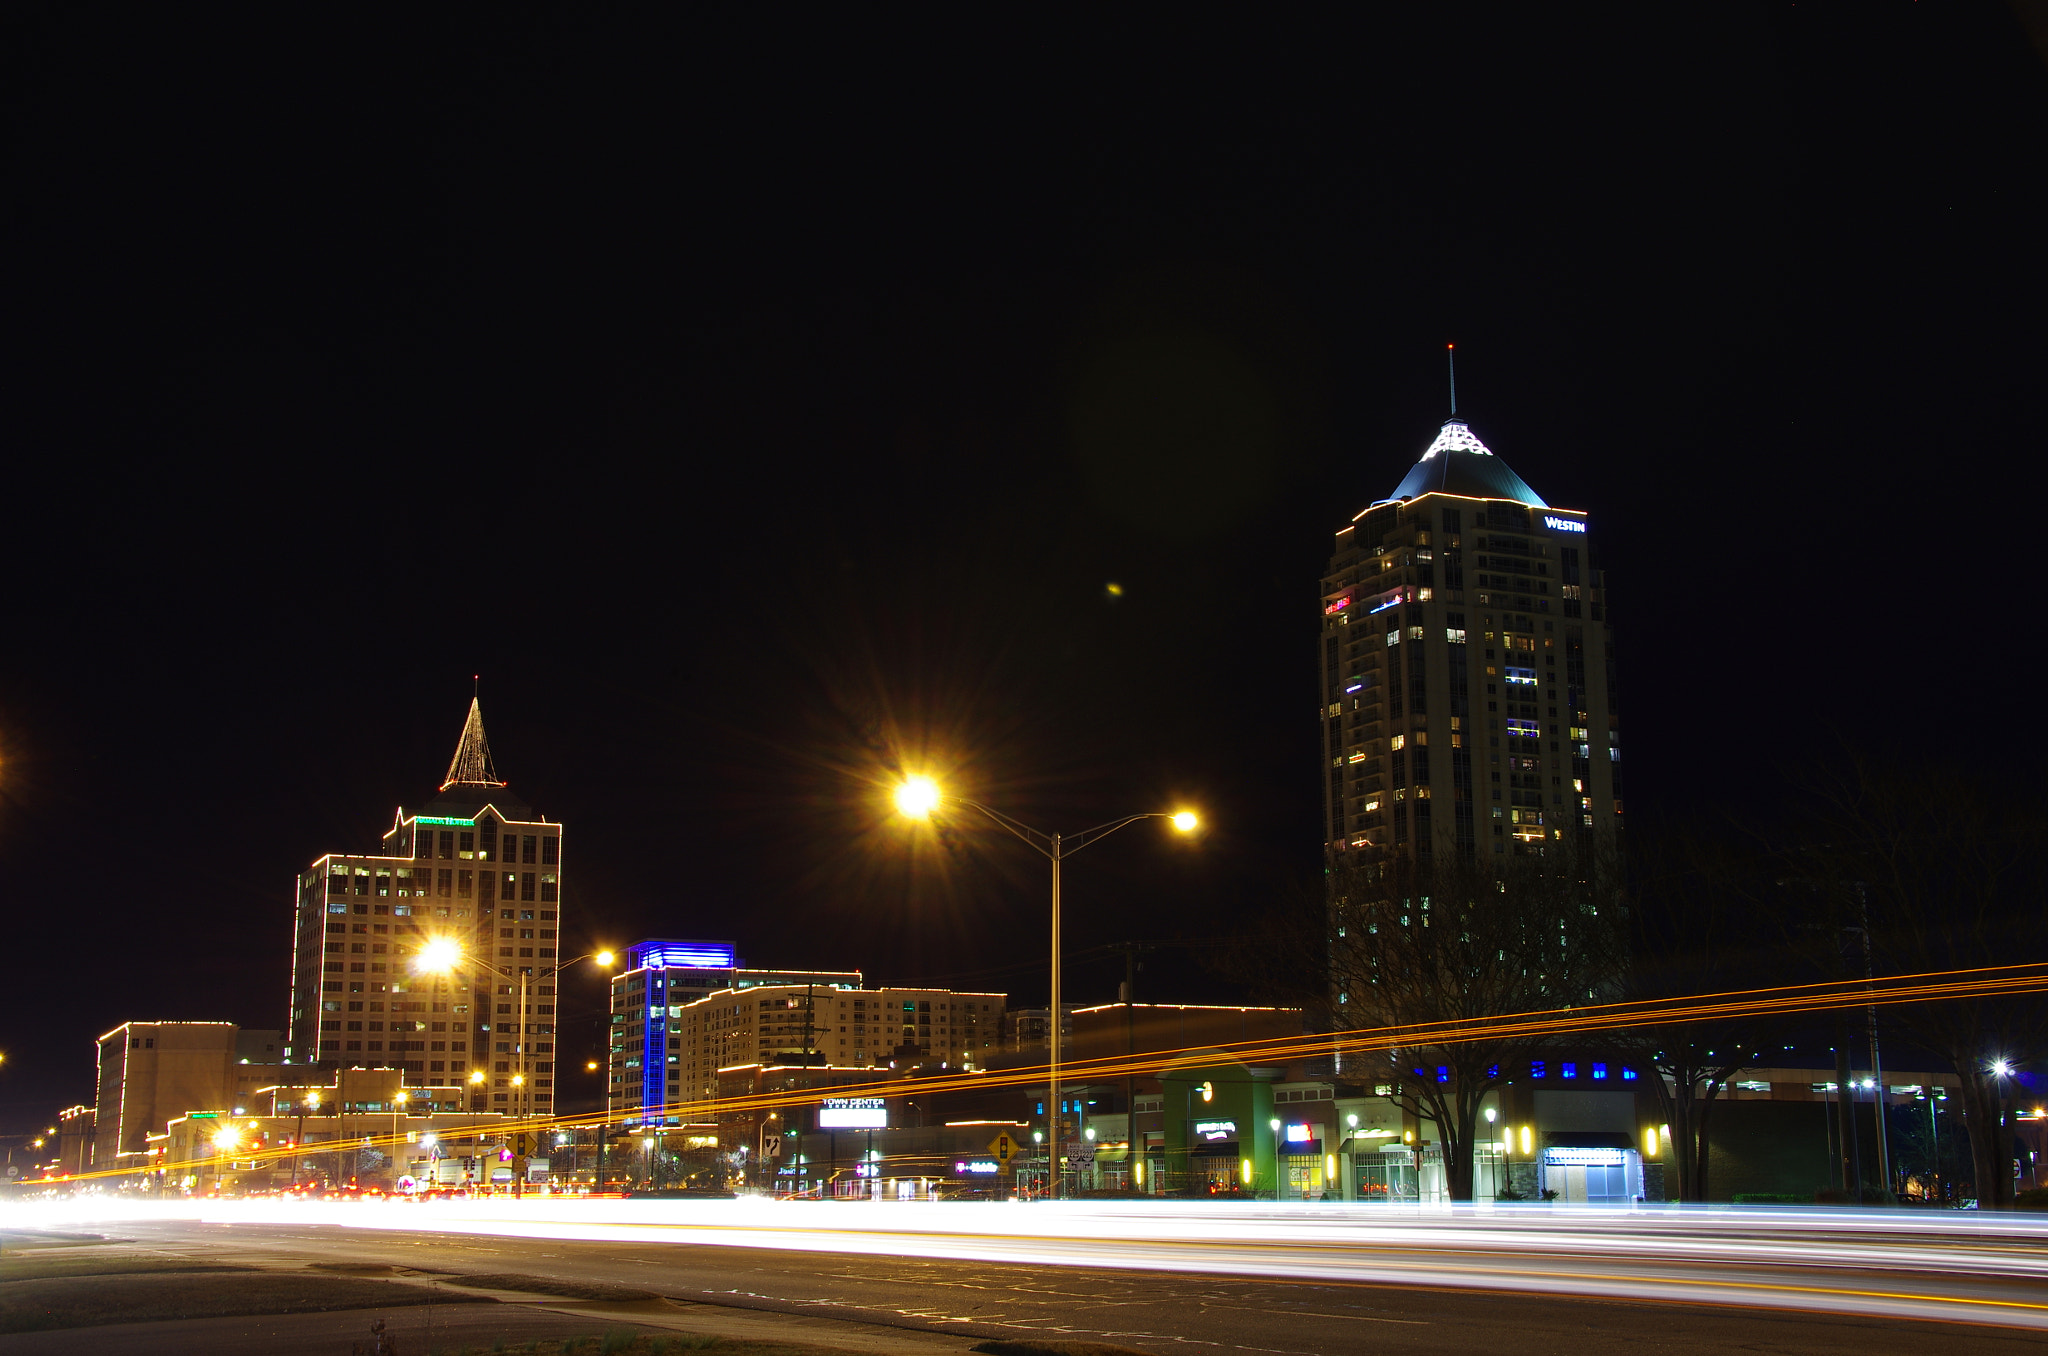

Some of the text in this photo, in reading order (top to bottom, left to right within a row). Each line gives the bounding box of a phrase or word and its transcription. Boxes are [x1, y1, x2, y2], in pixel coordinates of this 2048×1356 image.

[1544, 516, 1585, 532] WESTIN
[822, 1098, 885, 1106] TOWN CENTER
